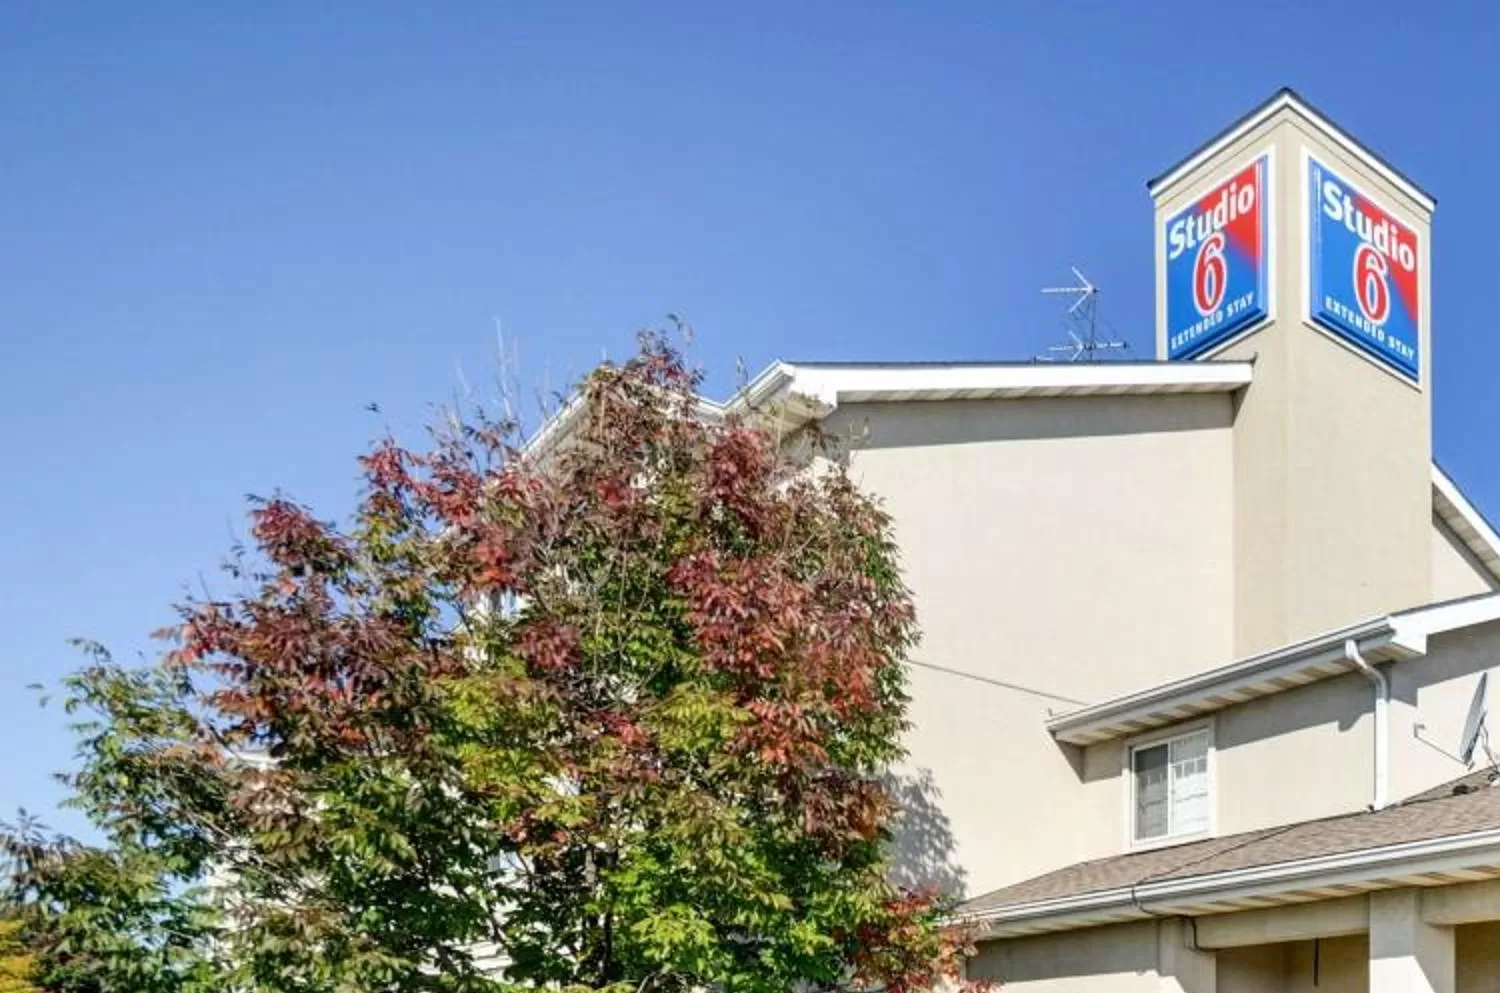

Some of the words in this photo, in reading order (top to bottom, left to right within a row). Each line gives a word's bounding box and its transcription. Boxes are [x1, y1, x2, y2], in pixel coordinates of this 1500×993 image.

[1169, 182, 1255, 261] Studio
[1322, 180, 1415, 272] Studio
[1192, 231, 1227, 317] 6
[1353, 242, 1390, 326] 6
[1170, 310, 1224, 350] EXTENDED
[1226, 291, 1255, 319] STAY
[1325, 295, 1385, 342] EXTENDED
[1387, 333, 1415, 362] STAY
